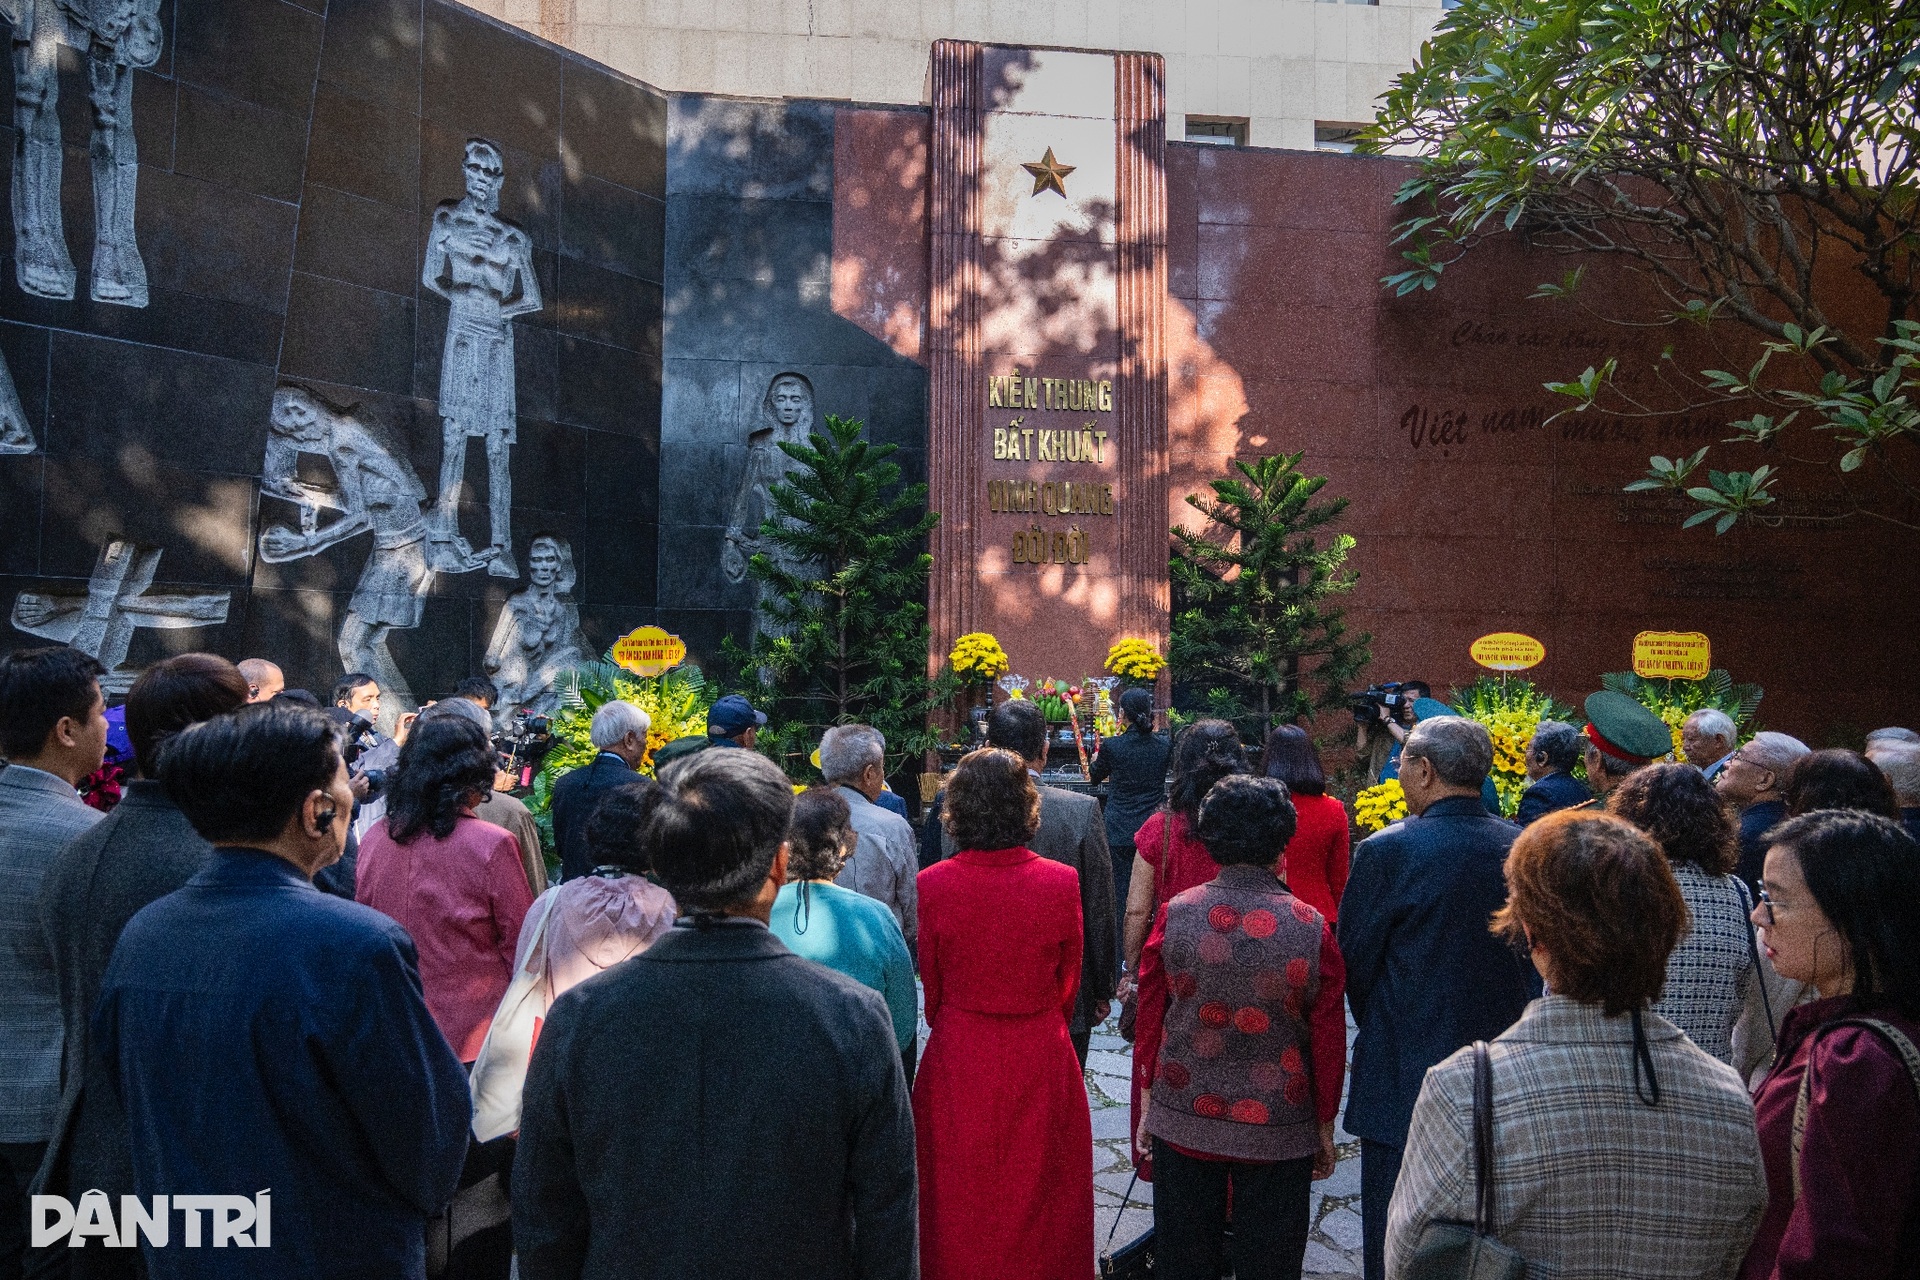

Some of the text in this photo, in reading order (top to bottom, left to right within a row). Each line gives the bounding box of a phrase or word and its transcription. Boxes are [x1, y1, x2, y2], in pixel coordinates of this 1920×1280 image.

[988, 368, 1112, 413] KIÊN TRUNG
[993, 416, 1107, 463] BẤT KHUẤT
[1401, 405, 1468, 458] Việt
[988, 480, 1113, 516] VINH QUANG
[1012, 523, 1089, 565] ĐỜI ĐỜI
